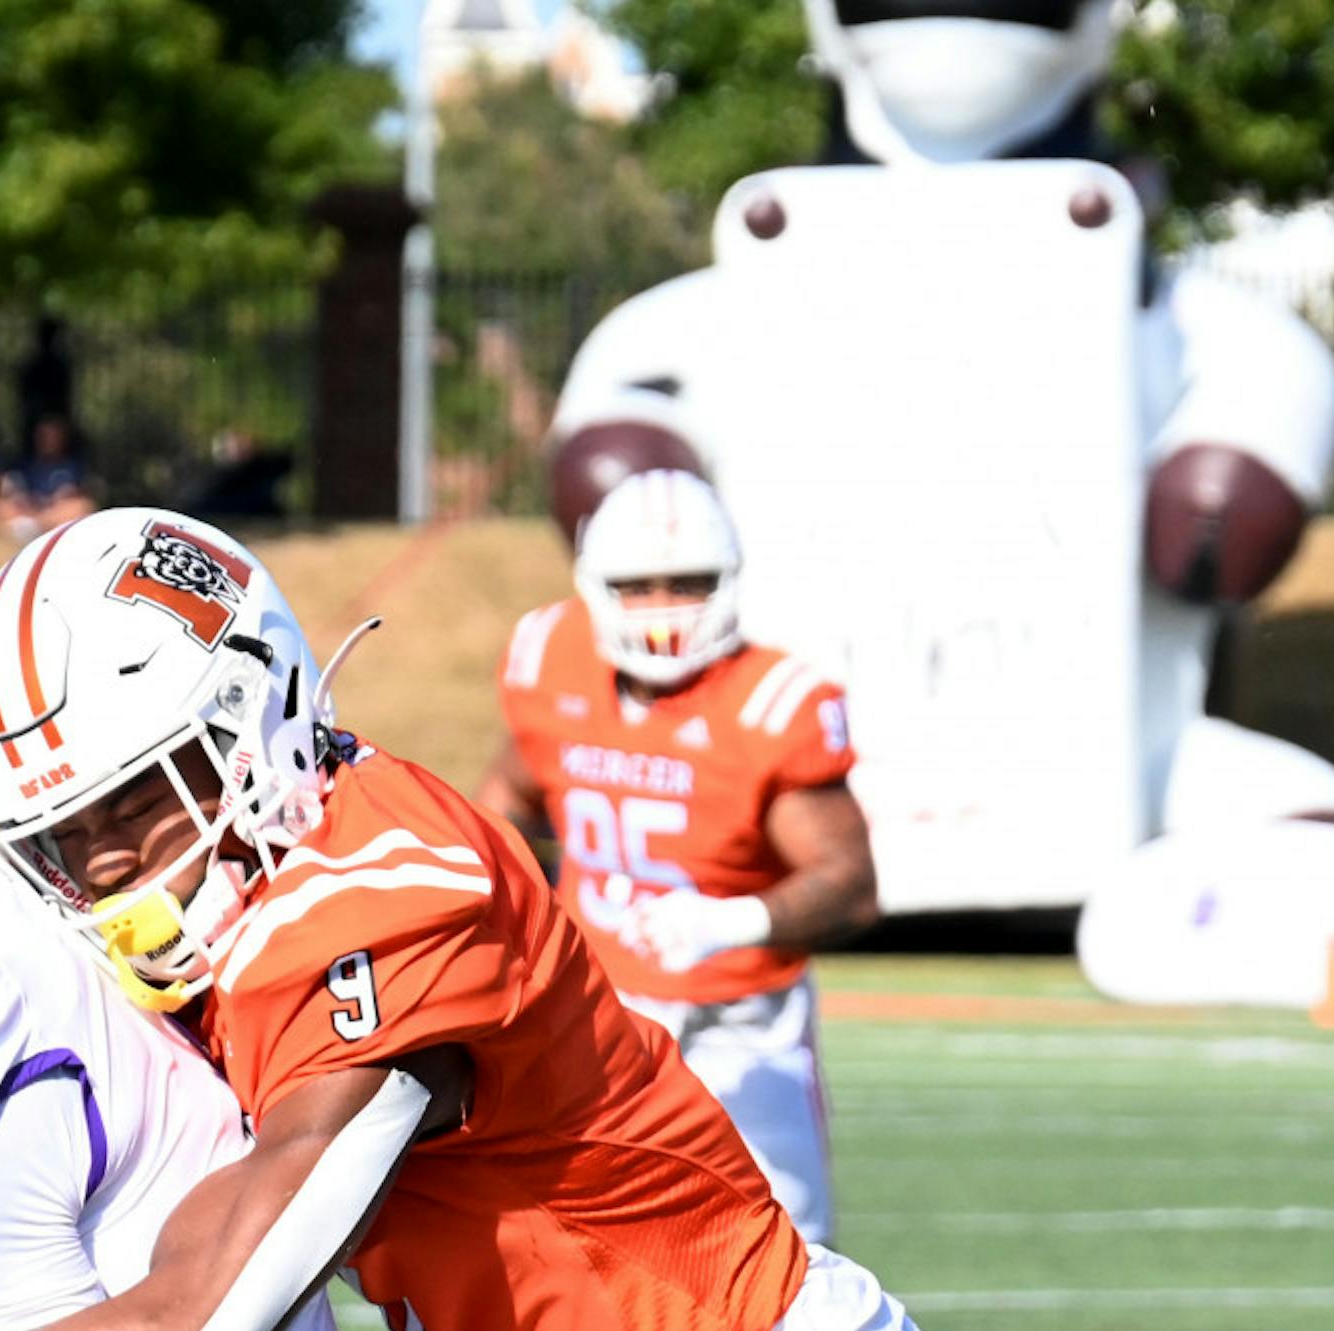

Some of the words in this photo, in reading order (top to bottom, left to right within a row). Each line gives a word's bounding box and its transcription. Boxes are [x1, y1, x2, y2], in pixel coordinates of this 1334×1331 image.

[560, 743, 694, 796] MERCER
[145, 927, 186, 962] Riddel
[326, 948, 382, 1043] 9
